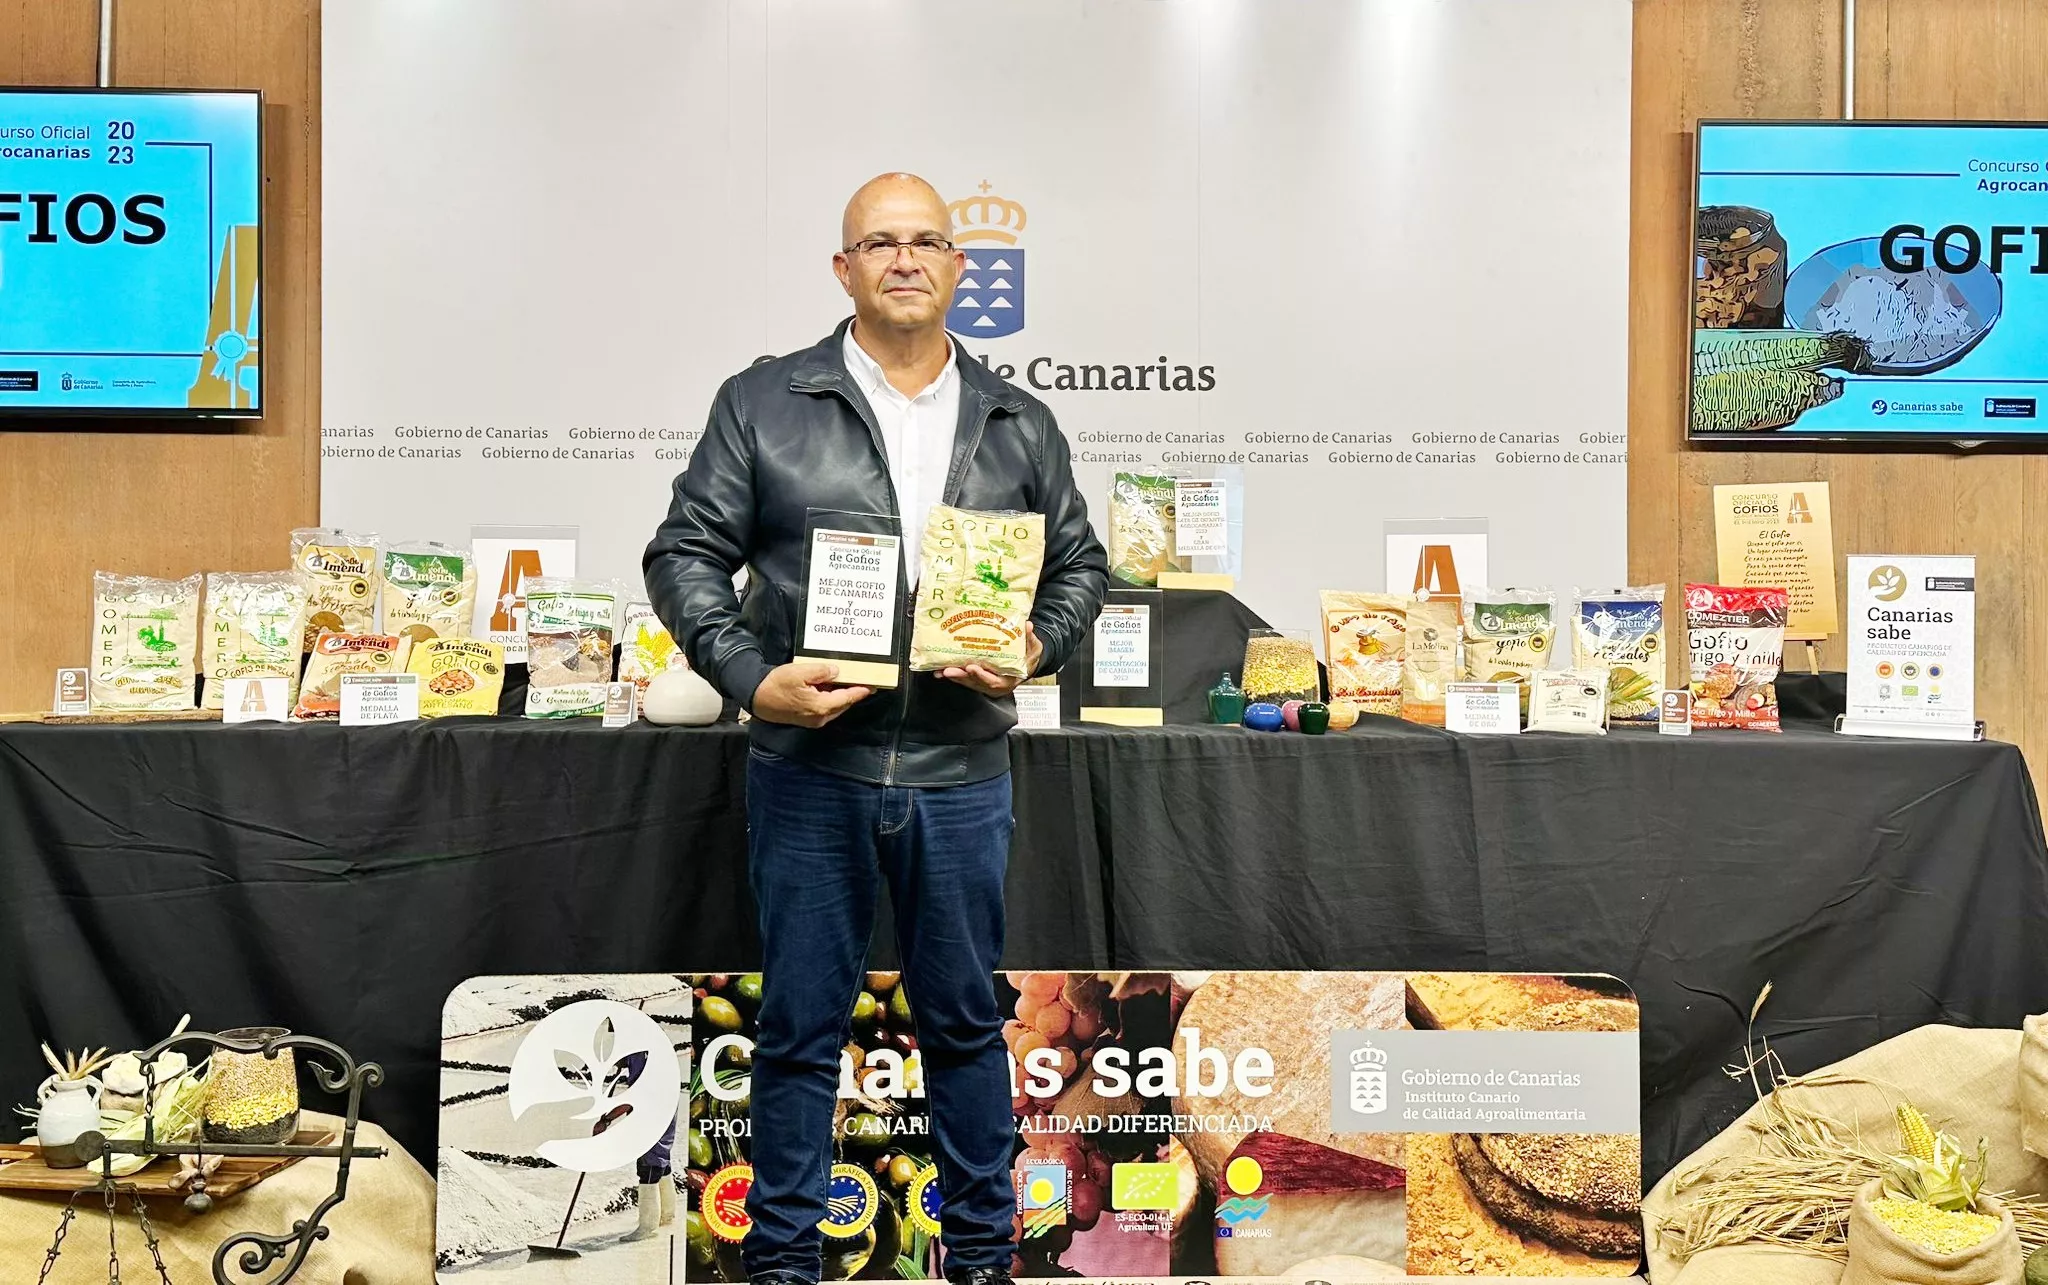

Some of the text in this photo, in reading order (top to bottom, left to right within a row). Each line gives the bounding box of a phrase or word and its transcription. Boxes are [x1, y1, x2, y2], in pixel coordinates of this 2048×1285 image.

[41, 125, 90, 139] Oficial
[107, 121, 135, 140] 20
[0, 146, 90, 158] ocanarias
[107, 146, 134, 164] 23
[1968, 159, 2039, 173] Concurso
[1028, 355, 1216, 392] Canarias
[1891, 401, 1963, 412] Canarias sabe
[395, 426, 549, 439] Gobierno de Canarias
[568, 427, 636, 440] Gobierno
[638, 427, 656, 440] de
[1078, 432, 1225, 443] Gobierno de Canarias
[1245, 432, 1392, 444] Gobierno de Canarias
[1412, 432, 1560, 444] Gobierno de Canarias
[1579, 432, 1628, 444] Gobier
[378, 446, 395, 458] de
[398, 446, 462, 459] Canarias
[482, 447, 635, 460] Gobierno de Canarias
[1081, 452, 1142, 463] Canarias
[1162, 452, 1309, 463] Gobierno de Canarias
[1328, 452, 1476, 463] Gobierno de Canarias
[1495, 452, 1560, 463] Gobierno
[1563, 452, 1580, 463] de
[1733, 505, 1779, 514] GOFIOS
[942, 519, 1028, 540] GOFIO
[1758, 529, 1791, 539] El Gofio
[829, 552, 880, 565] de Gofios
[828, 562, 880, 572] Agrocanarias
[819, 578, 885, 590] MEJOR GOFIO
[818, 587, 884, 600] DE CANARIAS
[537, 599, 564, 612] Gofio
[816, 606, 883, 618] MEJOR GOFIO
[842, 617, 856, 625] DE
[1867, 606, 1953, 623] Canarias
[813, 624, 882, 637] GRANO LOCAL
[1101, 620, 1112, 628] de
[1867, 624, 1911, 640] sabe
[489, 635, 528, 644] CONCU
[1689, 631, 1748, 651] Gofio
[430, 641, 493, 658] Almendi
[432, 655, 480, 671] GOFIO
[231, 665, 255, 679] GOFIO
[1091, 1026, 1275, 1099] sabe
[1401, 1069, 1582, 1088] Gobierno de Canarias
[1405, 1090, 1521, 1104] Instituto Canario
[1402, 1106, 1586, 1122] de Calidad Agroalimentaria
[1107, 1114, 1275, 1133] DIFERENCIADA
[1118, 1222, 1173, 1232] Agricultura UE
[1235, 1228, 1272, 1238] CANARIAS
